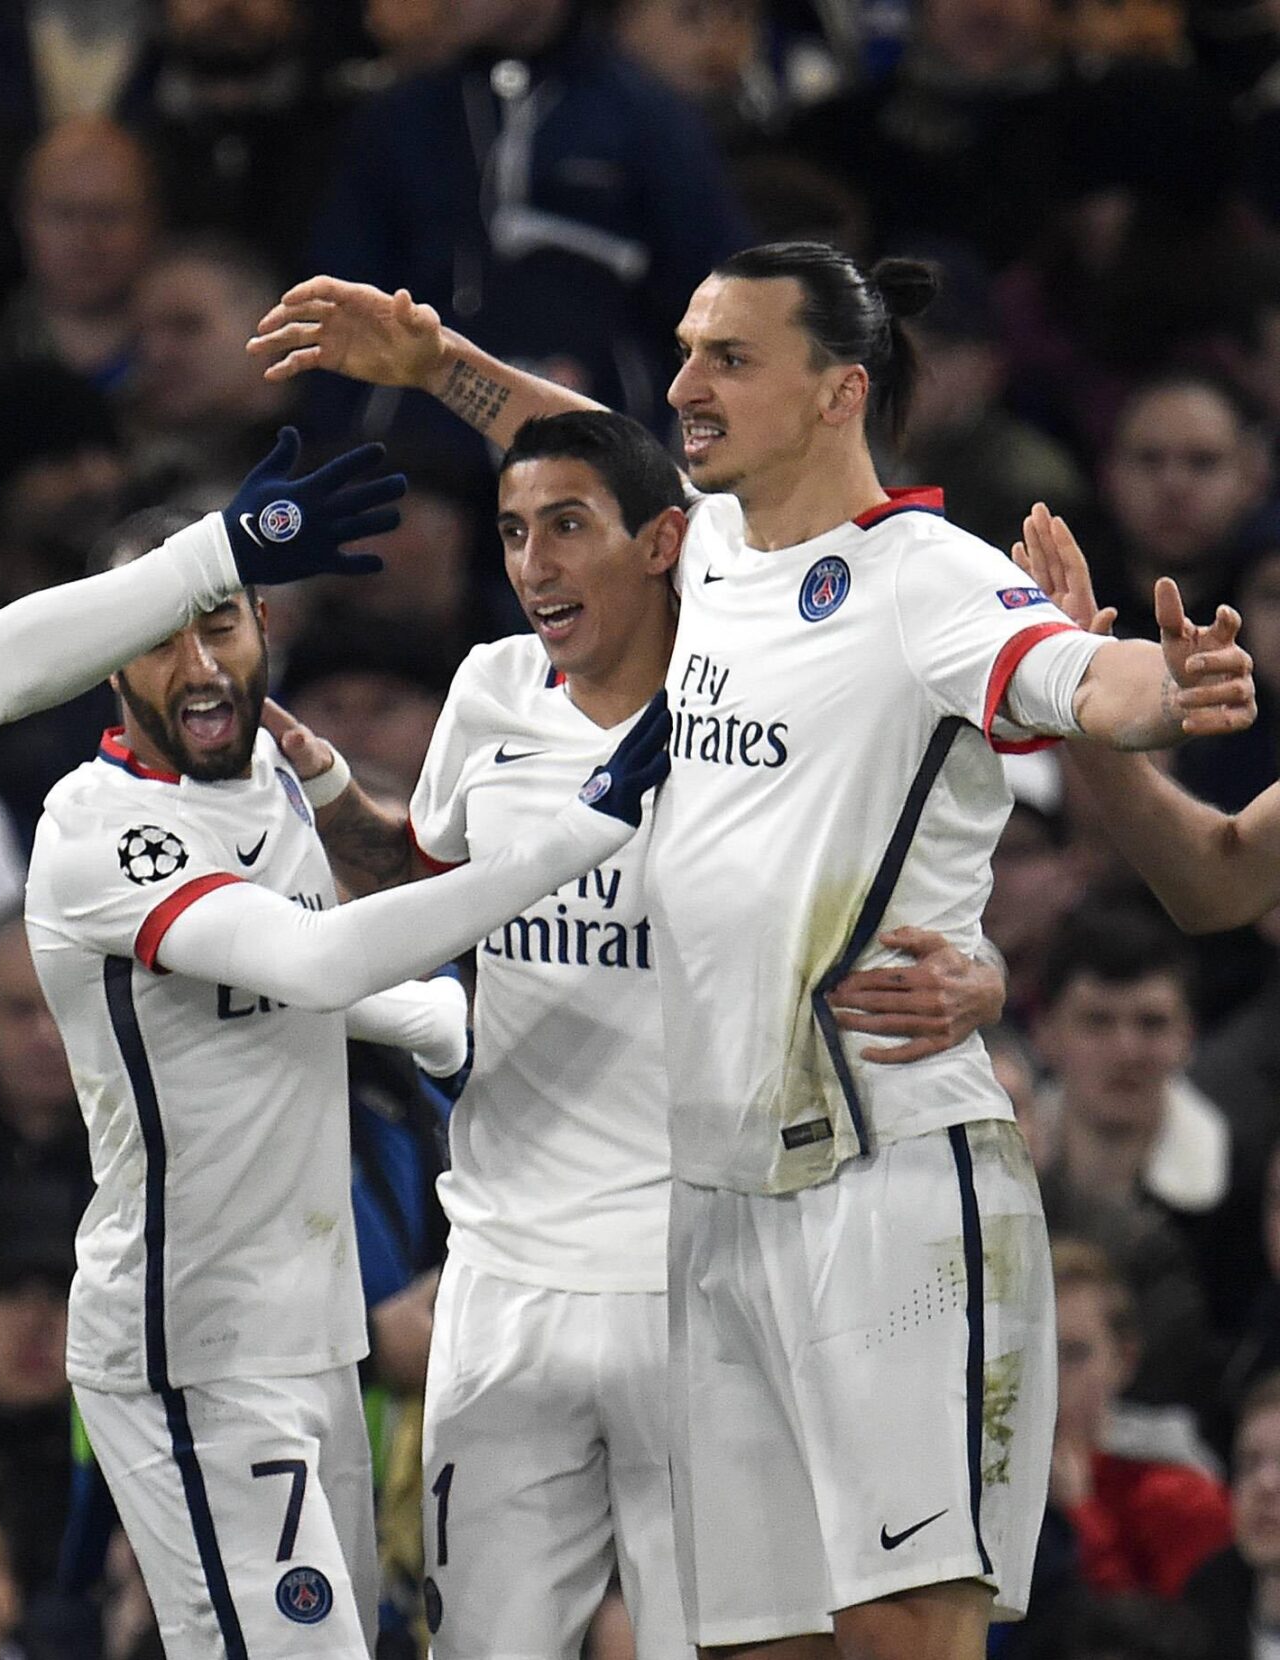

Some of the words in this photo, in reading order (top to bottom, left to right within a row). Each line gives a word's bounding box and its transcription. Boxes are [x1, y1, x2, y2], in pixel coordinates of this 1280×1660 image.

[680, 653, 730, 706] Fly
[551, 867, 622, 910] ly
[250, 1459, 308, 1562] 7
[431, 1462, 456, 1567] 1
